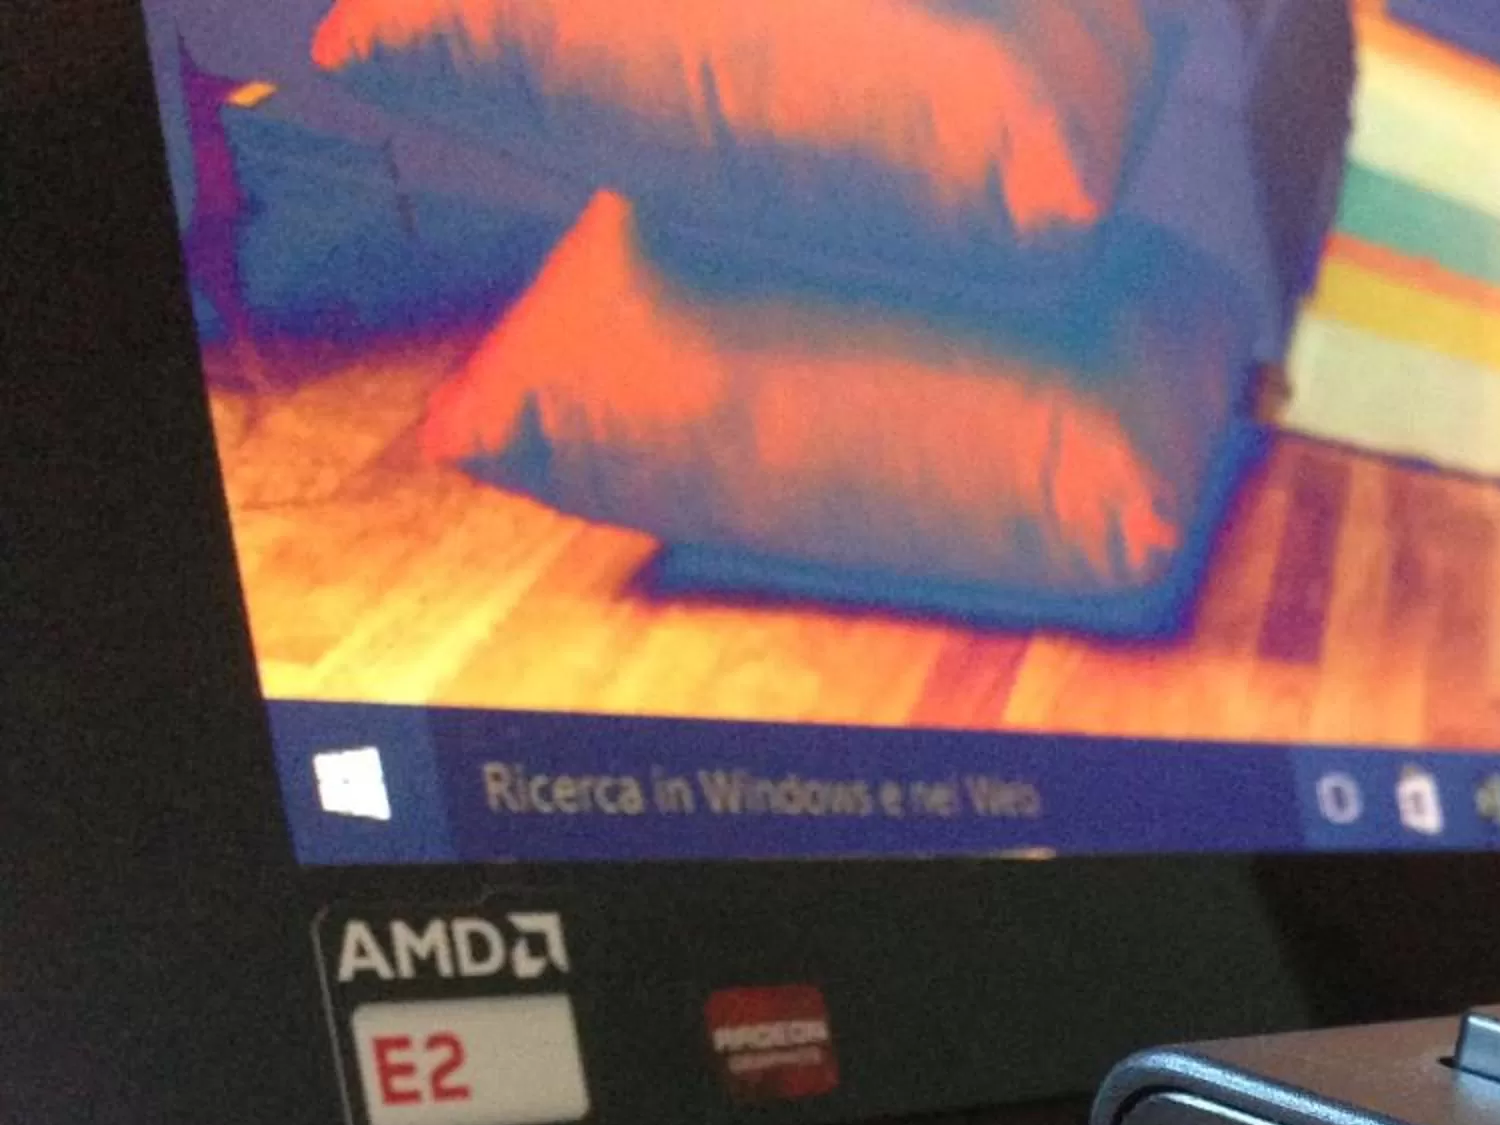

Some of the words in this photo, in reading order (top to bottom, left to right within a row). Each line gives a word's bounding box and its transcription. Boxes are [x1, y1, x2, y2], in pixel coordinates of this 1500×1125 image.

[483, 761, 645, 816] Ricerca
[652, 764, 696, 816] in
[697, 768, 873, 818] Windows
[337, 917, 506, 983] AMD
[371, 1030, 474, 1105] E2
